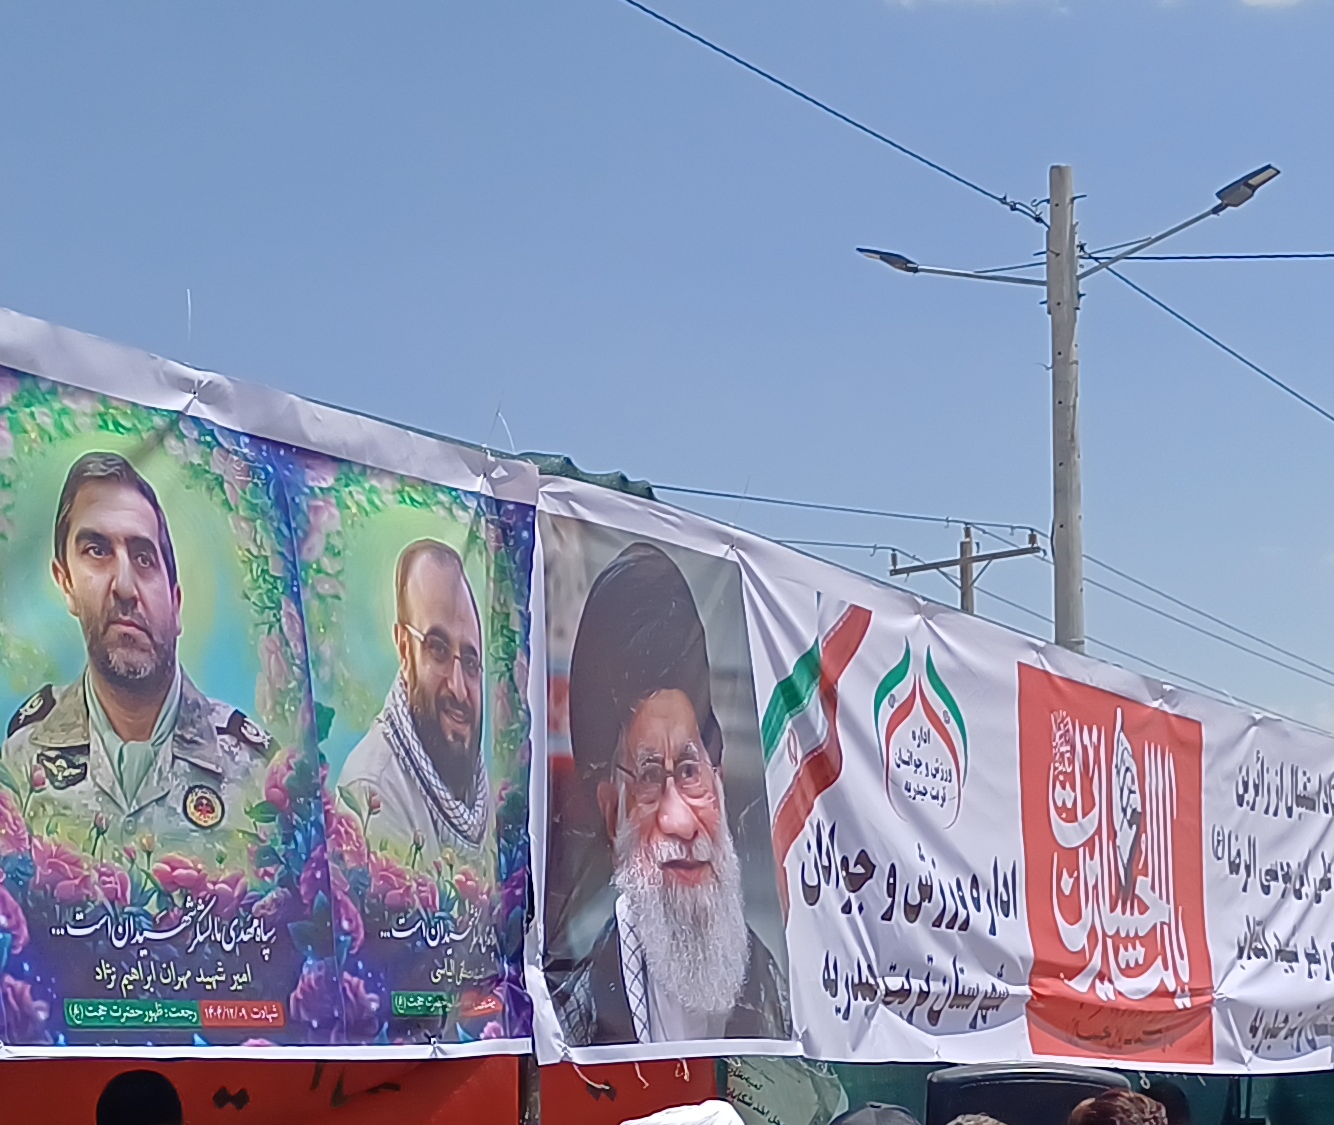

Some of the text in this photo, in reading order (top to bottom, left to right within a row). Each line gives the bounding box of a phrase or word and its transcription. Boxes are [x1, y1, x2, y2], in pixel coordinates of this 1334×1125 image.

[801, 818, 1018, 937] اداره ورزش و جوانان
[120, 960, 157, 998] ابراهیم
[159, 960, 192, 990] مهران
[195, 961, 226, 990] شهید
[229, 963, 252, 991] امیر
[250, 1006, 279, 1023] شهادت
